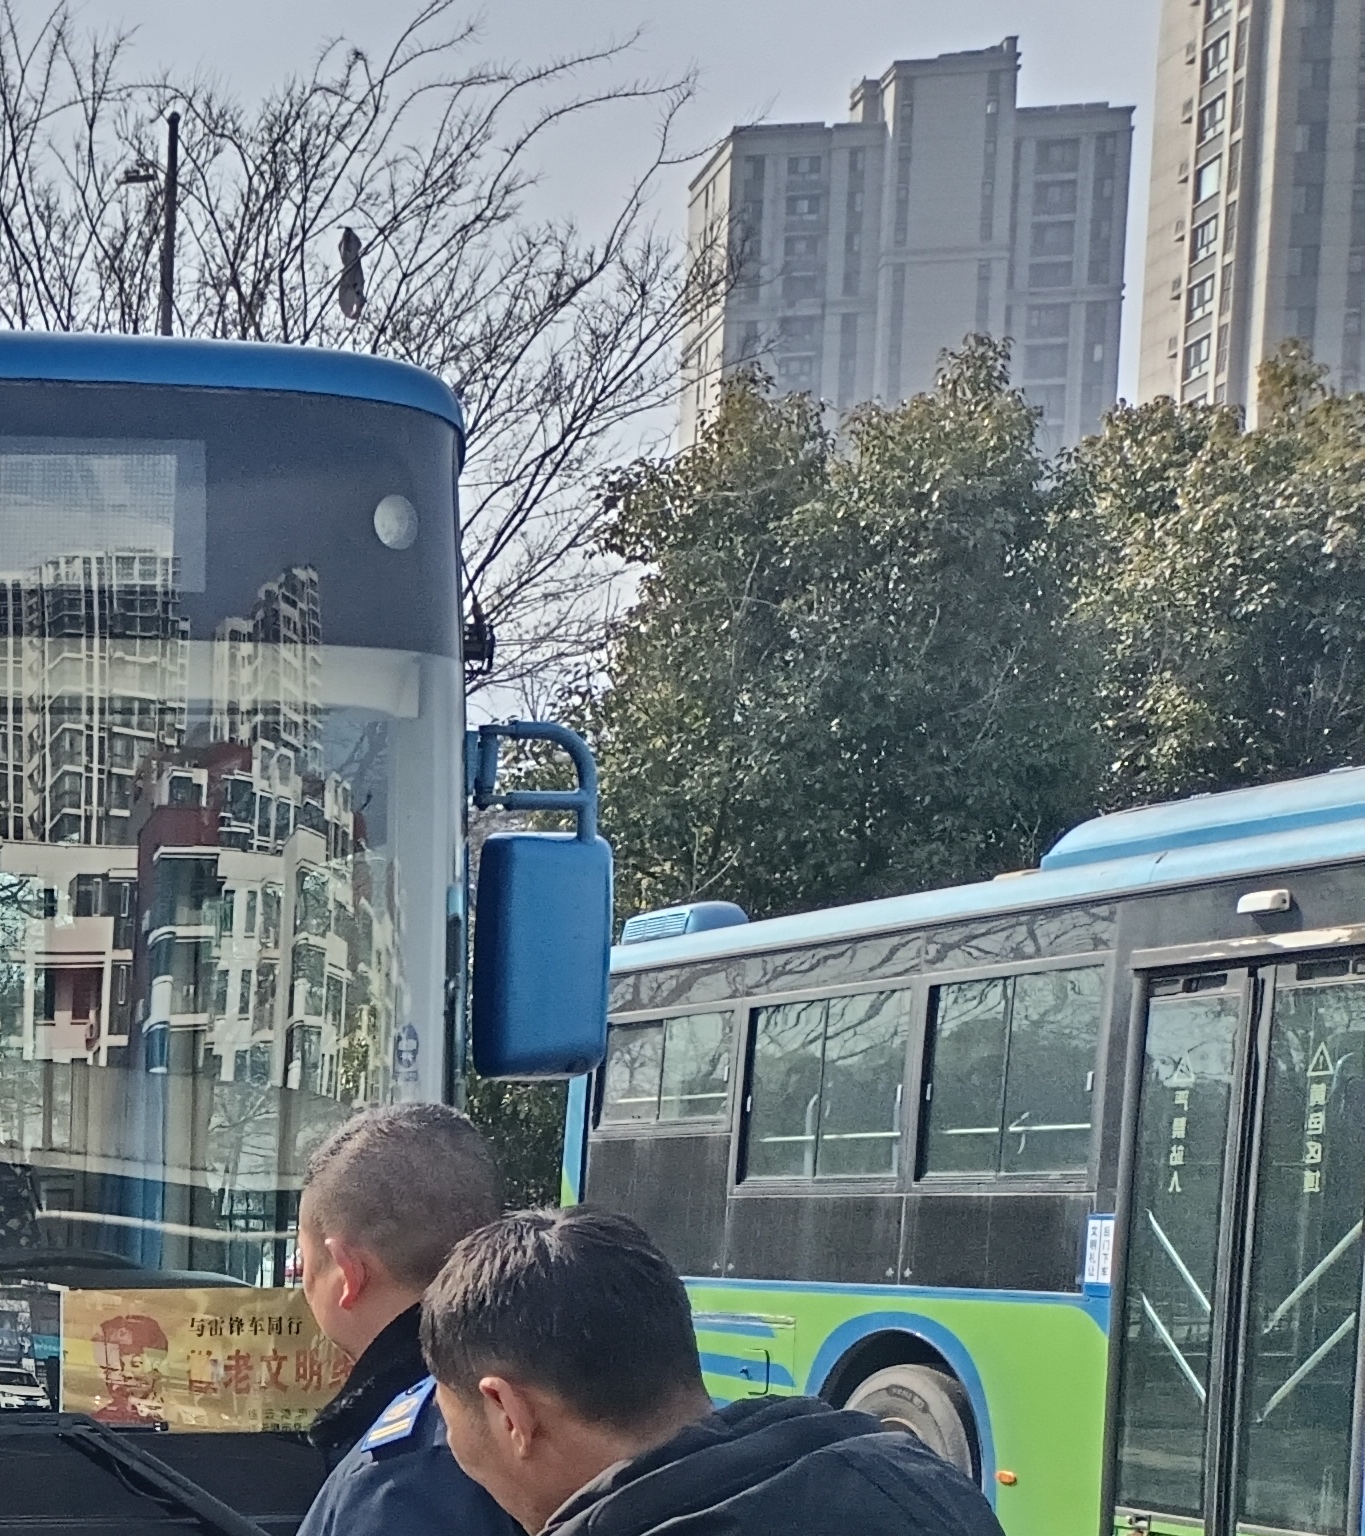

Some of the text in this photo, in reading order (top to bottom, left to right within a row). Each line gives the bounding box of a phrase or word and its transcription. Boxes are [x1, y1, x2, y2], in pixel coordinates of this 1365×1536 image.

[189, 1315, 303, 1337] 与雷锋车同行
